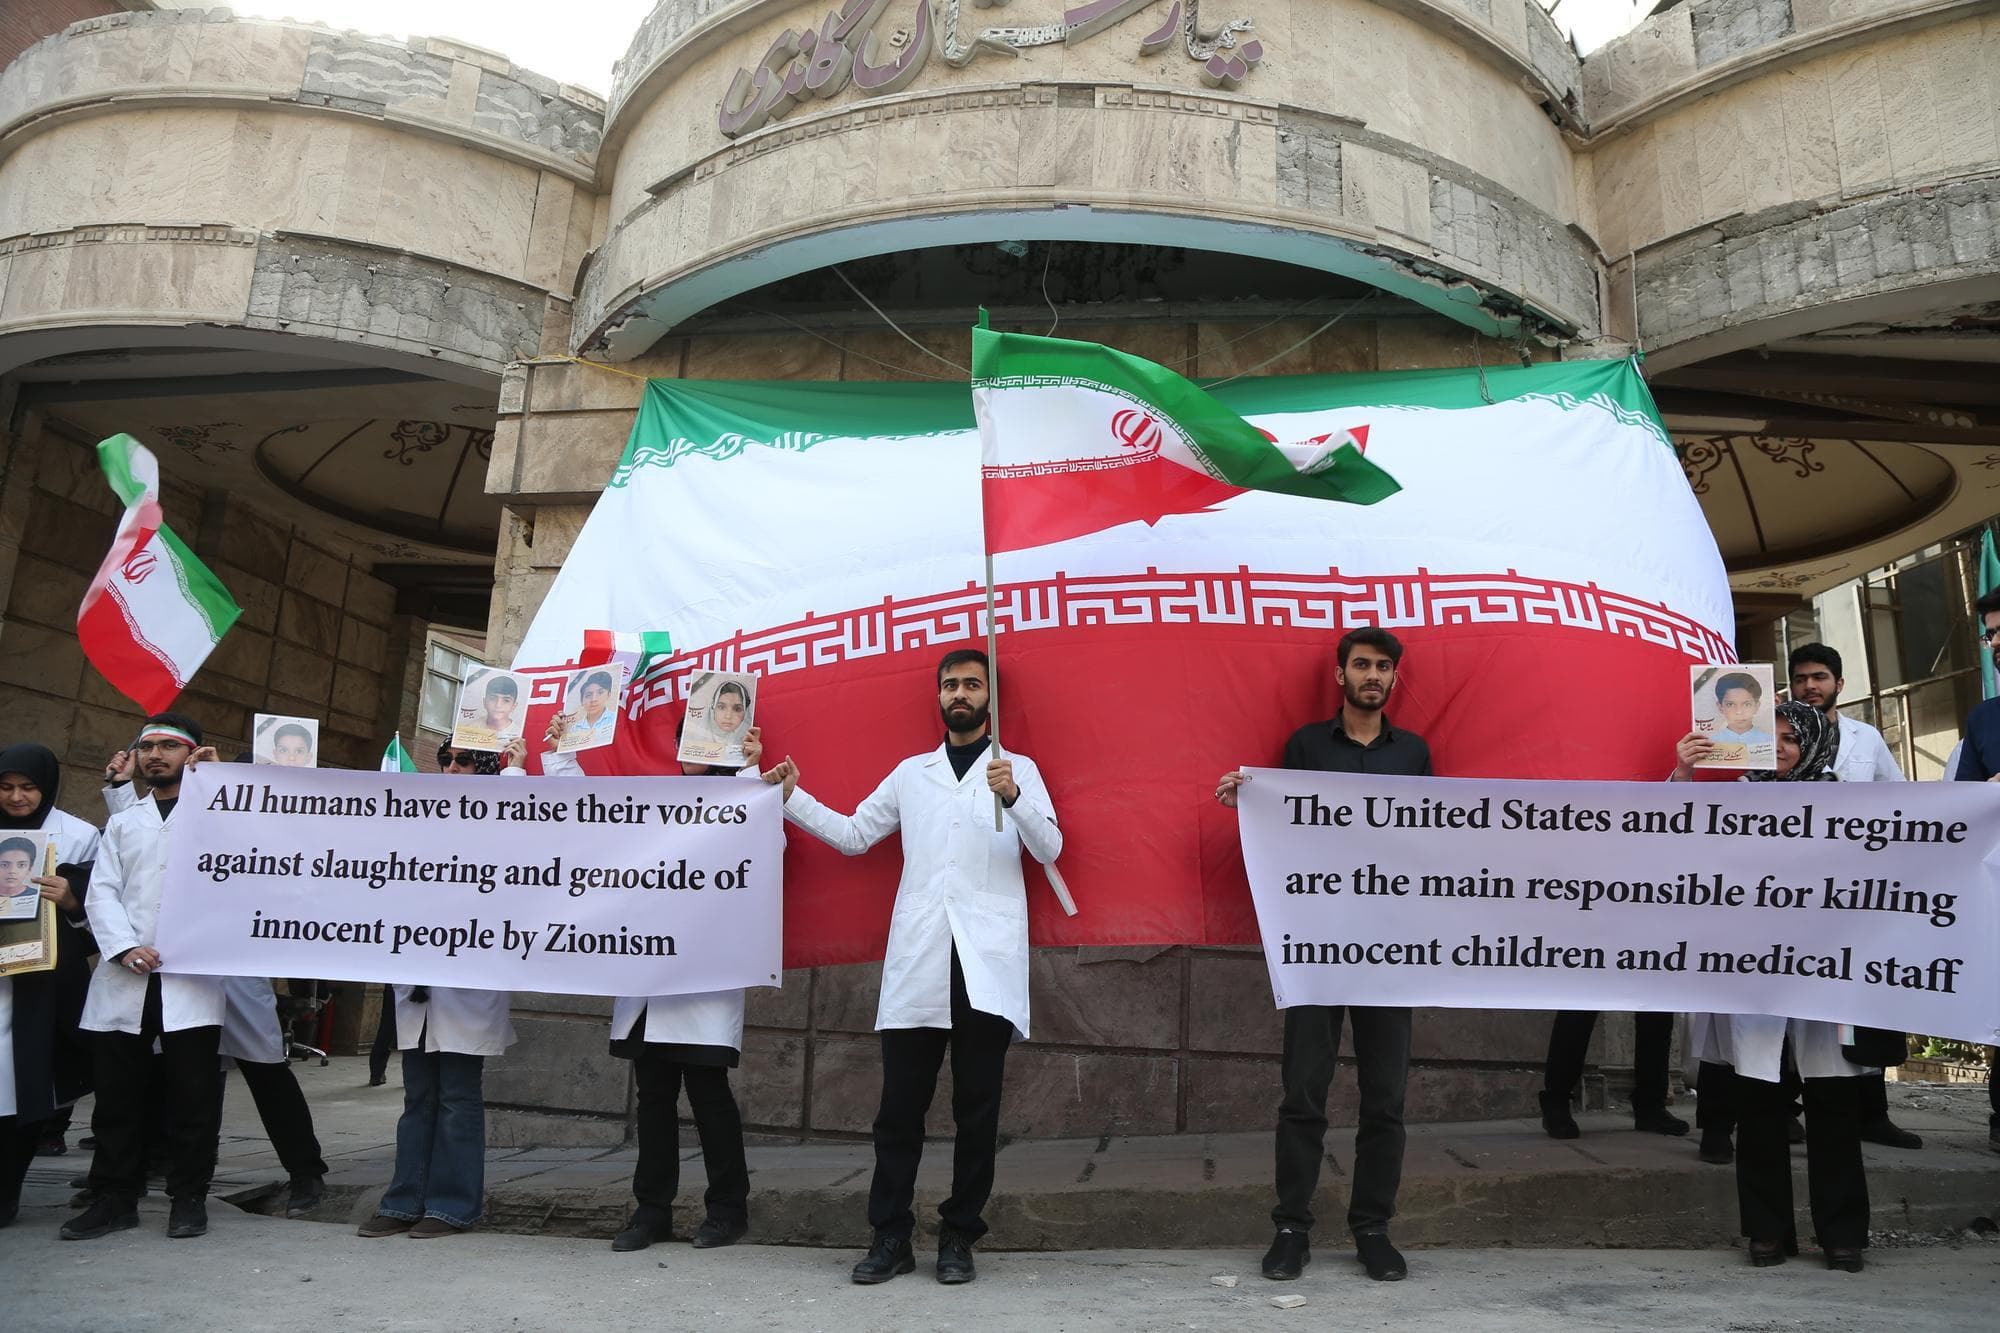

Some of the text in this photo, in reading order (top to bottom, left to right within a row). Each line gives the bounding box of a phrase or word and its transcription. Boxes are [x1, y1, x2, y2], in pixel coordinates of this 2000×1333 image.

[206, 783, 747, 825] All humans have to raise their voices
[1283, 793, 1968, 852] The United States and Israel regime
[197, 847, 752, 898] against slaughtering and genocide of
[1285, 863, 1959, 928] are the main responsible for killing
[250, 910, 678, 961] innocent people by Zionism
[1281, 933, 1964, 994] innocent children and medical staff
